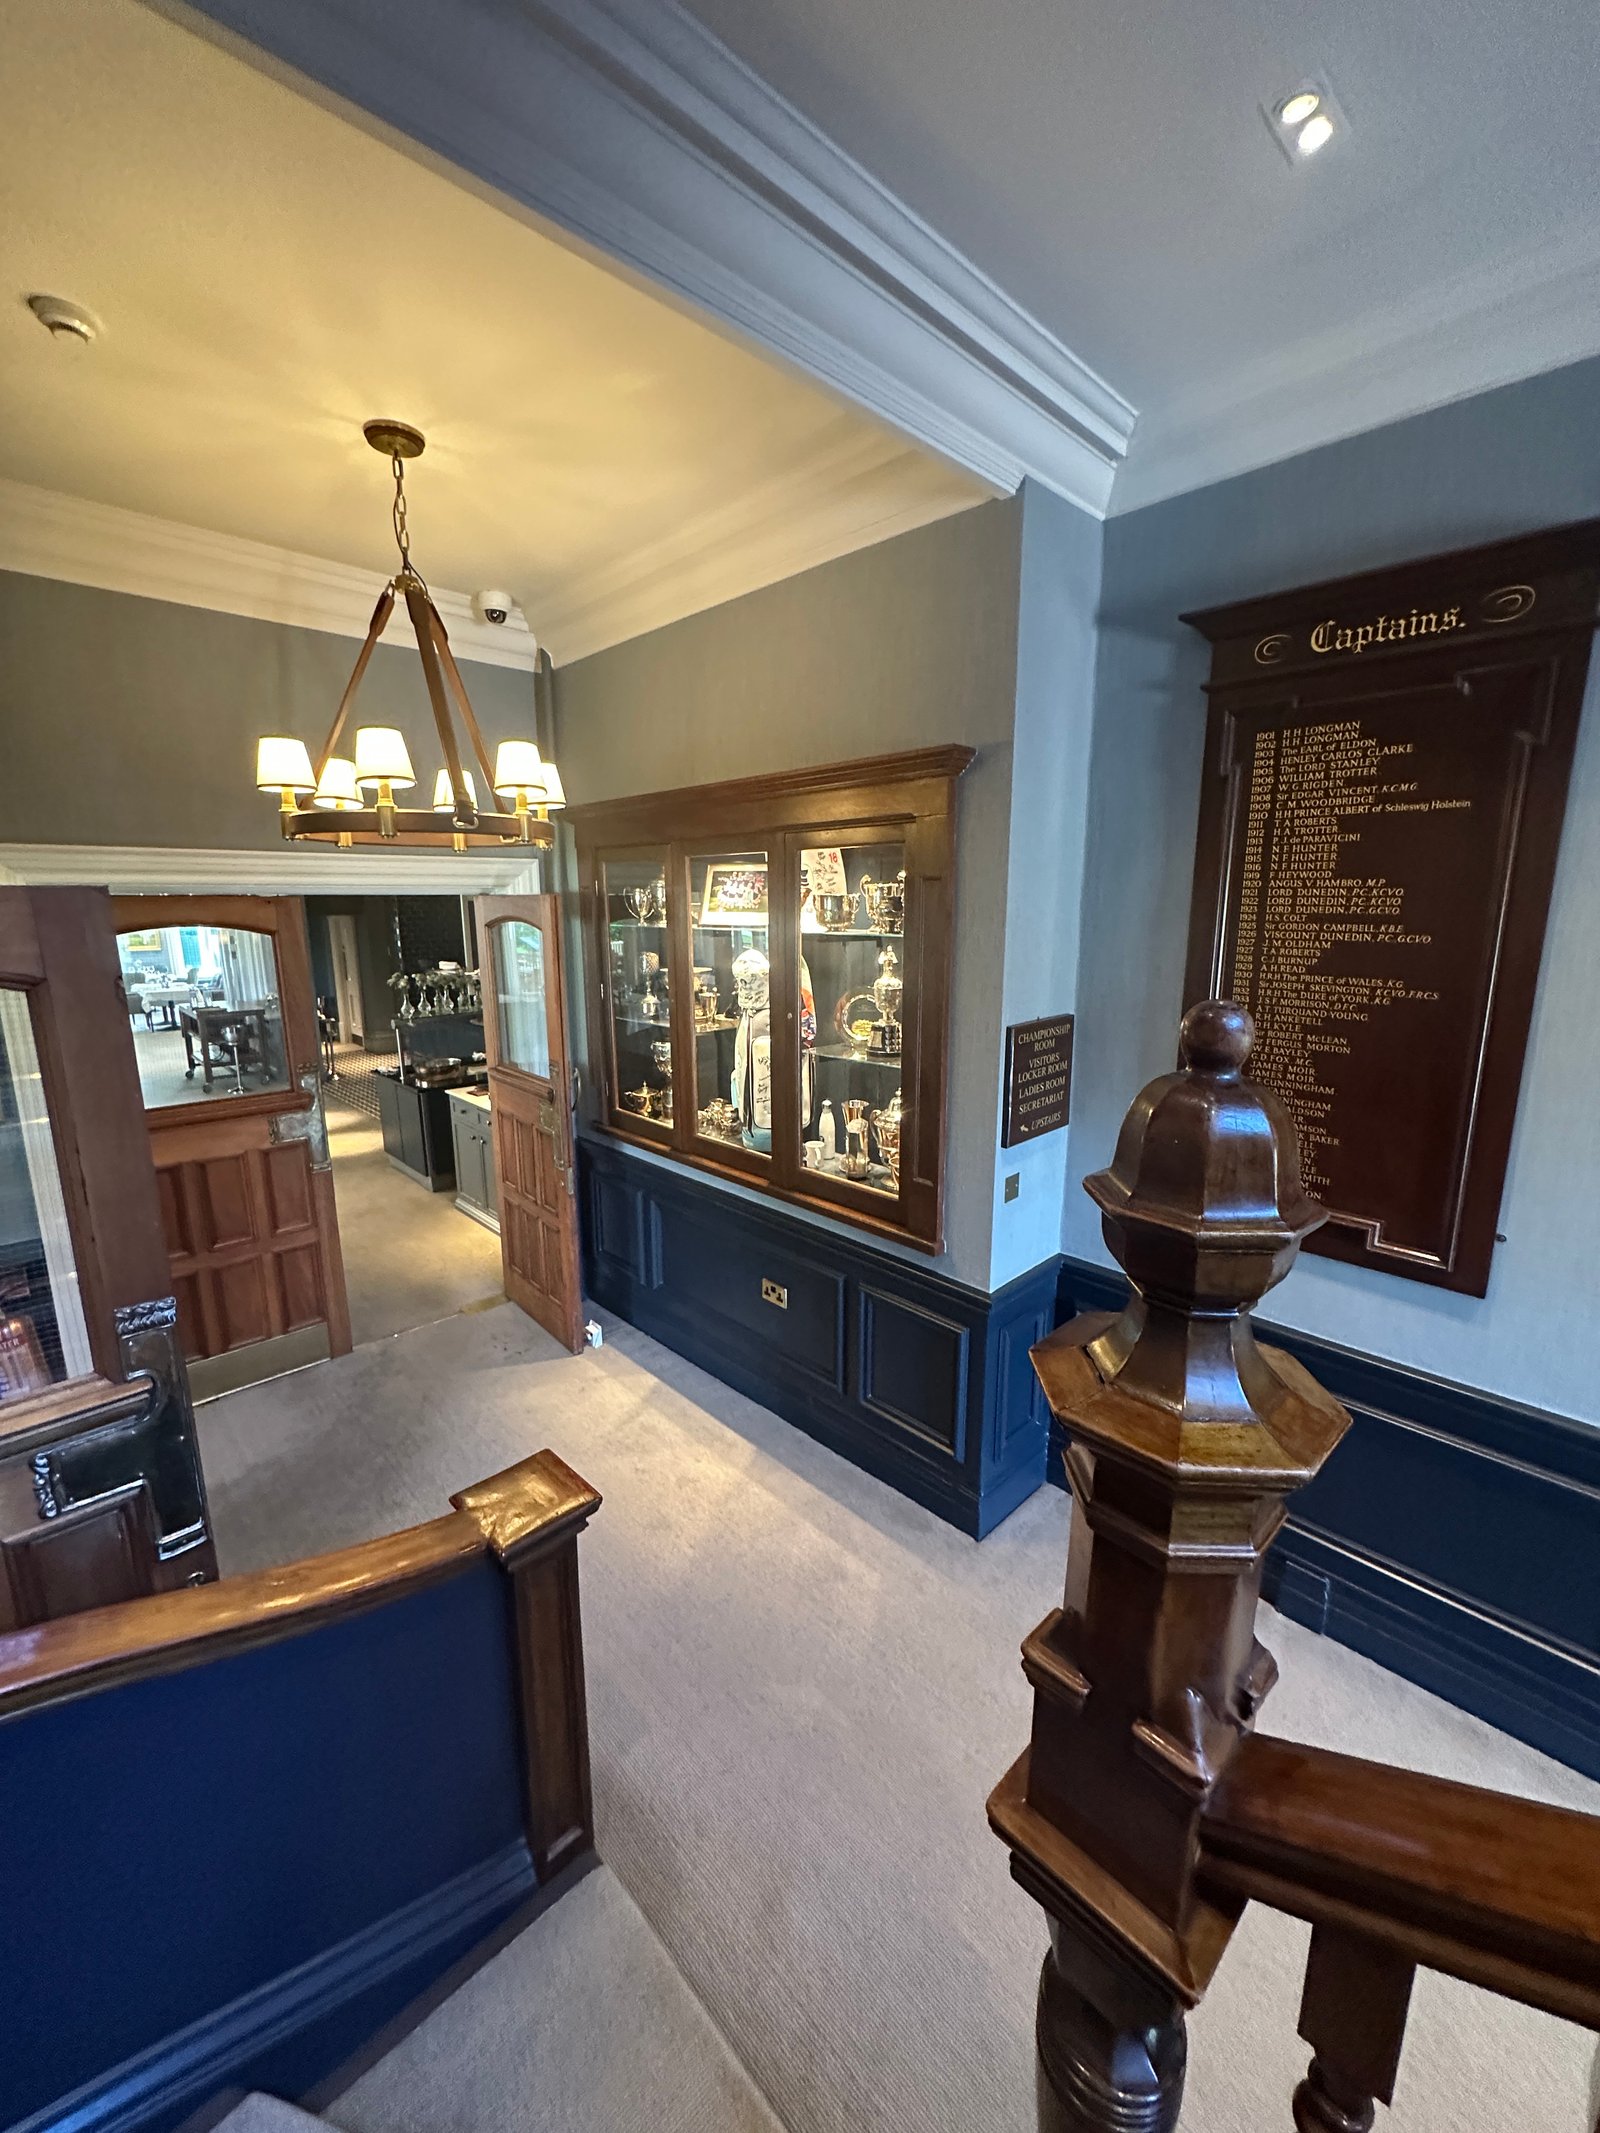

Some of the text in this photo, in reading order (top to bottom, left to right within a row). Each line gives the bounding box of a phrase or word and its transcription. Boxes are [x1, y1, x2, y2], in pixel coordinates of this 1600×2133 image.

[1018, 1024, 1071, 1045] CHAMPIONSHIP
[1034, 1038, 1056, 1052] ROOM
[1029, 1052, 1060, 1068] VISITORS
[1018, 1060, 1068, 1084] LOCKER ROOM
[1019, 1076, 1066, 1099] LADIES ROOM
[1019, 1091, 1064, 1114] SECRETARIAT
[1031, 1112, 1061, 1130] UPSTAIRS
